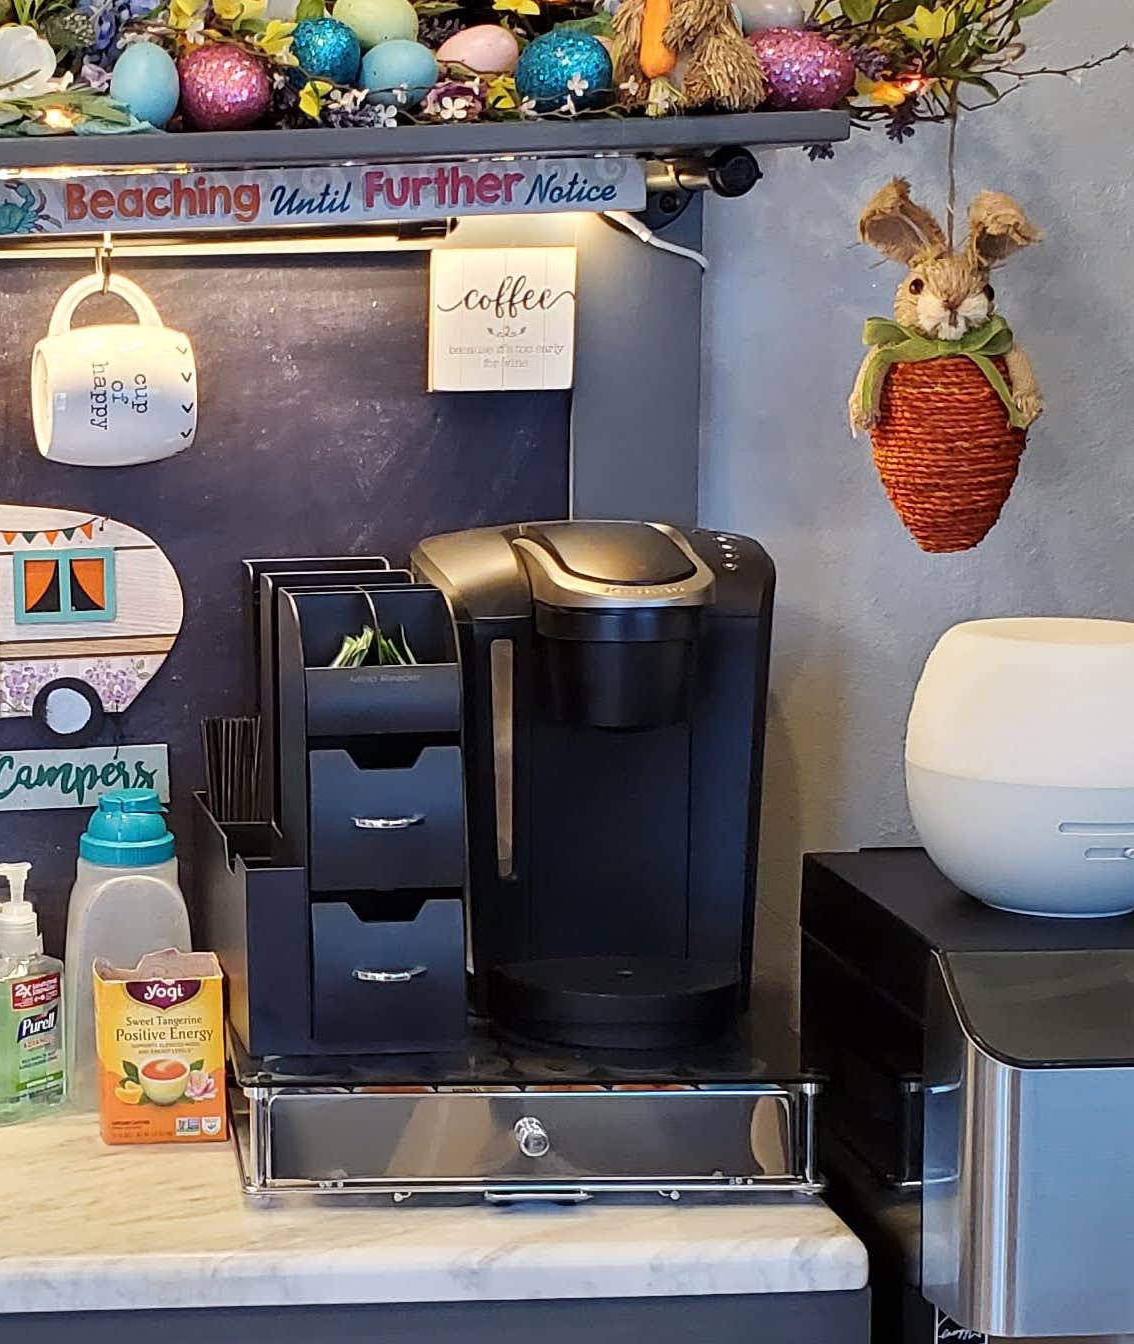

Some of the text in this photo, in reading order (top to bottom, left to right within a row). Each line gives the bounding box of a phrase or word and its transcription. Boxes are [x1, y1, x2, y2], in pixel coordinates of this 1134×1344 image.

[66, 166, 618, 224] Beaching Until Further Notice
[437, 275, 575, 319] coffee
[89, 361, 109, 431] happy
[110, 380, 129, 405] of
[130, 373, 148, 414] cup
[21, 1010, 55, 1037] Purell
[115, 1027, 214, 1043] Positive Energy
[125, 1015, 203, 1027] Sweet Tangerine
